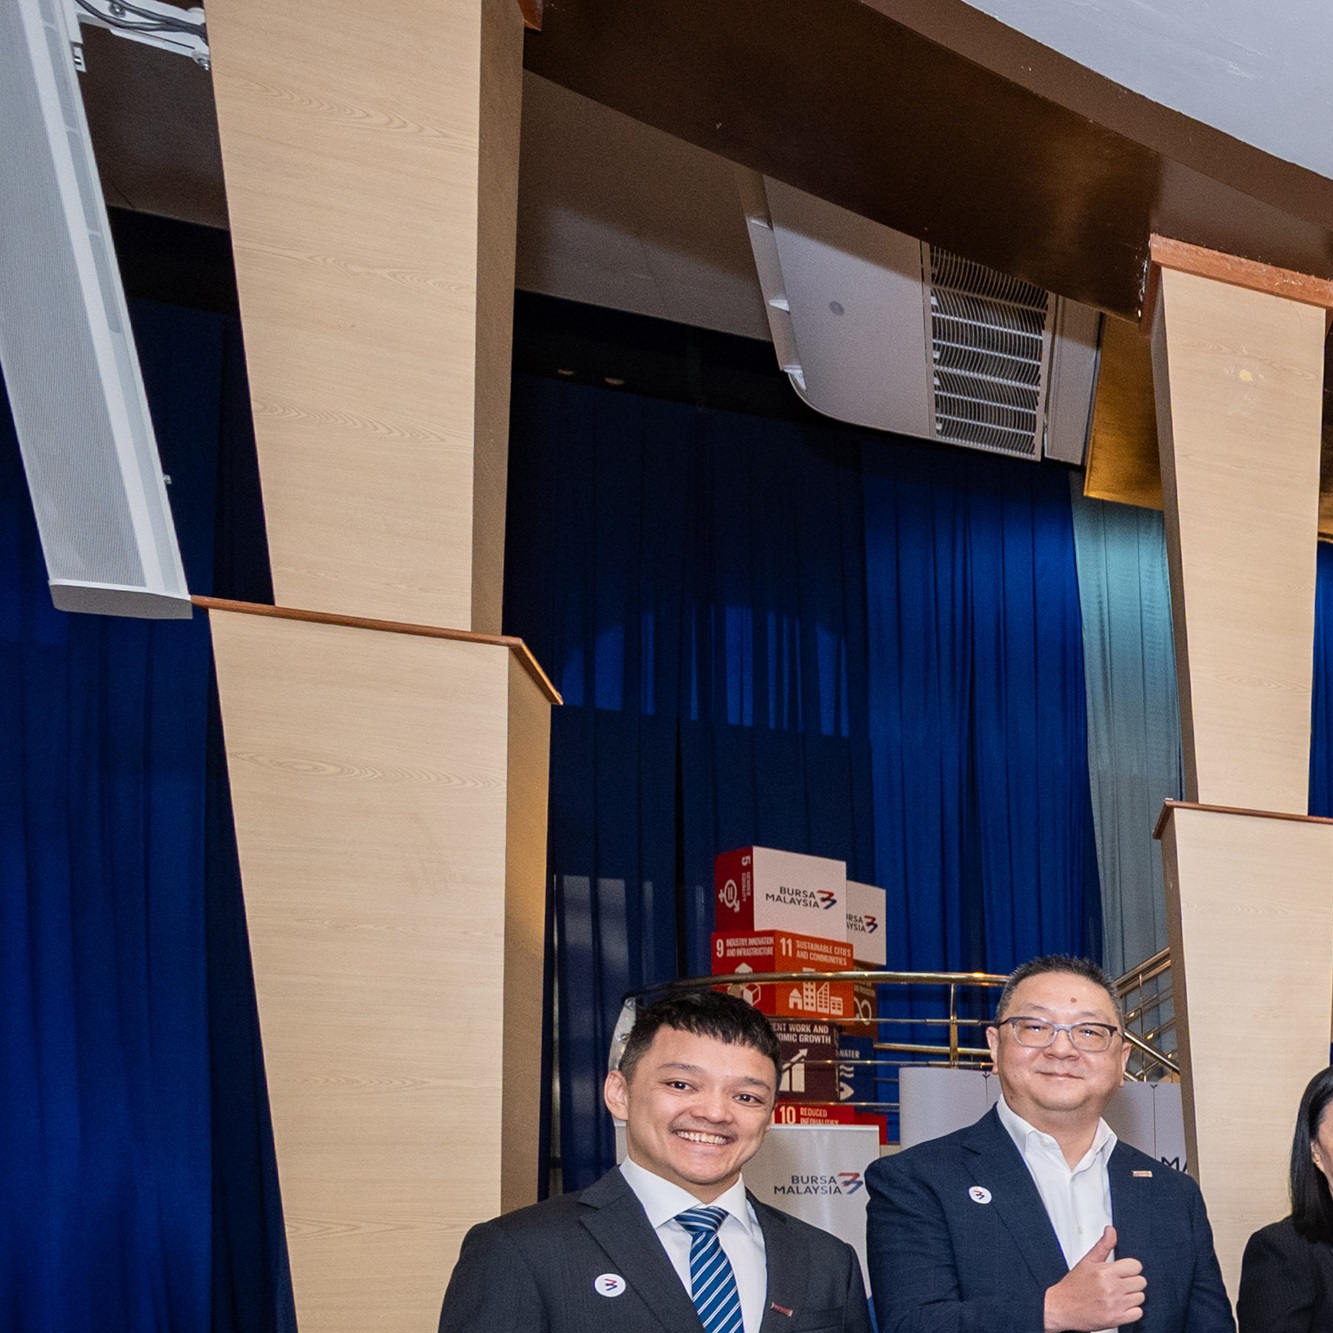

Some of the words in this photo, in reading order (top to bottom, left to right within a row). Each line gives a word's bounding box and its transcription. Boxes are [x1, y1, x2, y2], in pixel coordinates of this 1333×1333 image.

[779, 886, 816, 900] BURSA
[765, 893, 820, 909] MALAYSIA
[846, 913, 864, 924] RSA
[716, 938, 724, 958] 9
[780, 937, 793, 957] 11
[796, 950, 809, 960] AND
[772, 1022, 787, 1032] ENT
[789, 1023, 812, 1033] WORK
[813, 1025, 829, 1034] AND
[777, 1032, 798, 1042] OMIC
[799, 1034, 832, 1045] GROWTH
[779, 1105, 796, 1124] 10
[800, 1107, 828, 1118] REDUCED
[791, 1175, 838, 1185] BURSA
[773, 1186, 843, 1195] MALAYSIA
